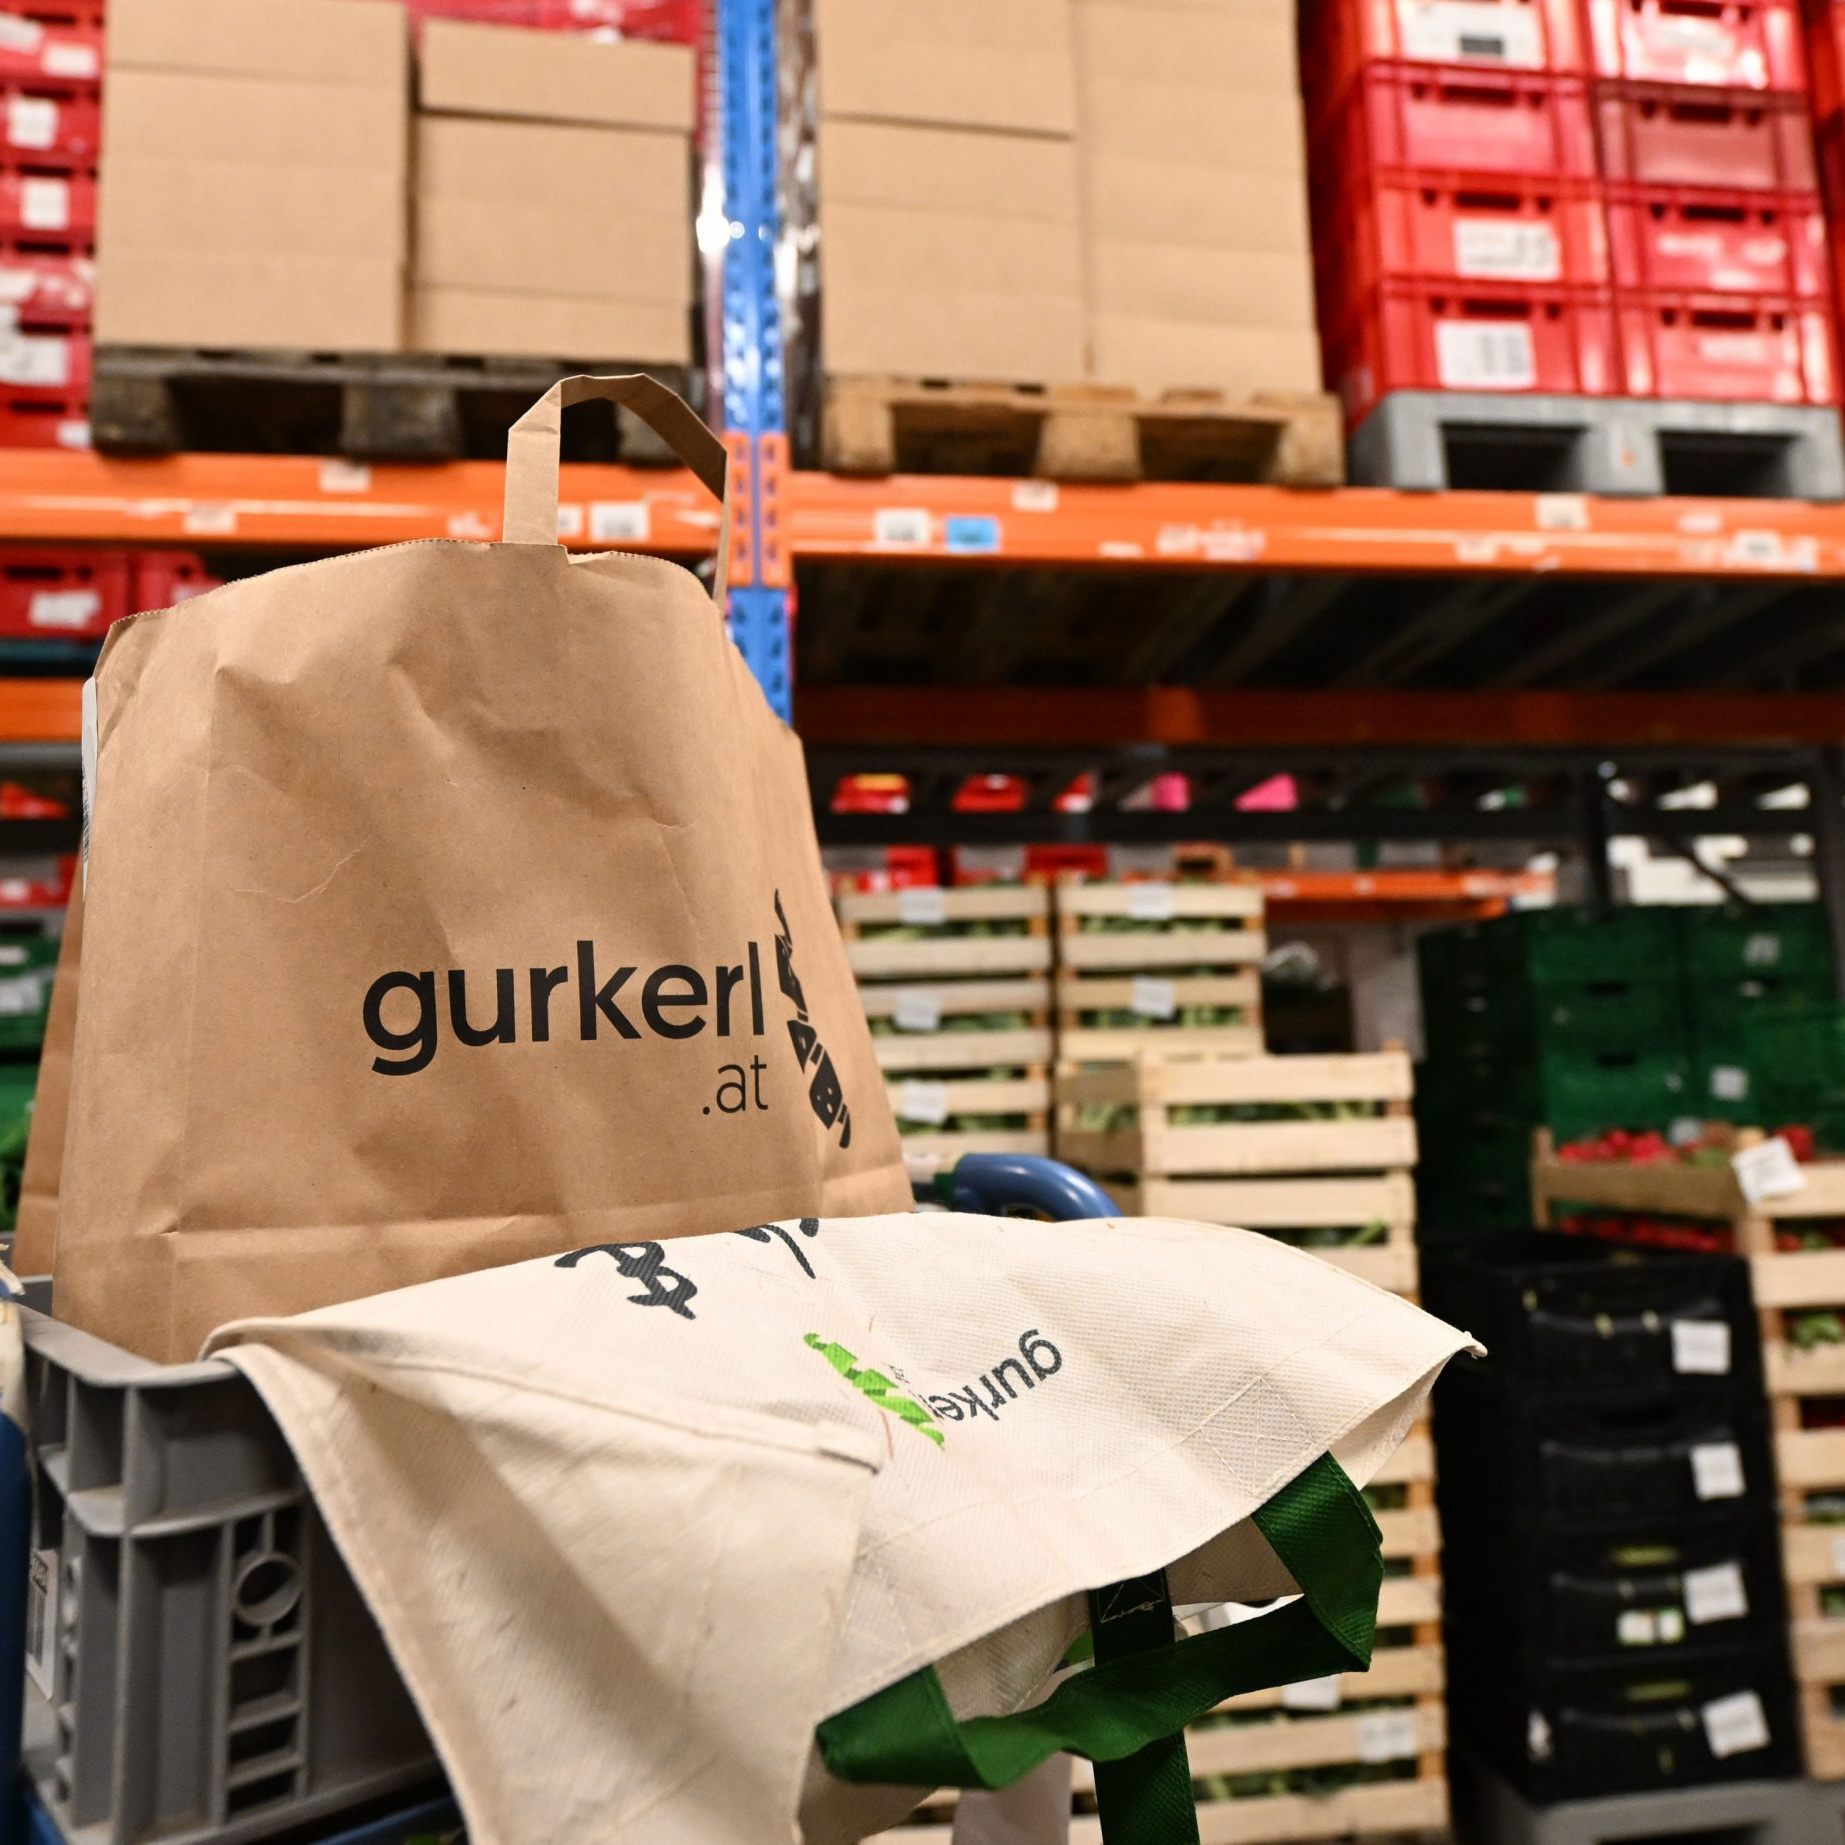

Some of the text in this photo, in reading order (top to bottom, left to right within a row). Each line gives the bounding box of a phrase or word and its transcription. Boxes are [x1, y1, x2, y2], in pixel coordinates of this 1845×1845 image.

[362, 939, 766, 1077] gurkerl
[702, 1054, 769, 1115] .at
[920, 1328, 1063, 1422] gurke
